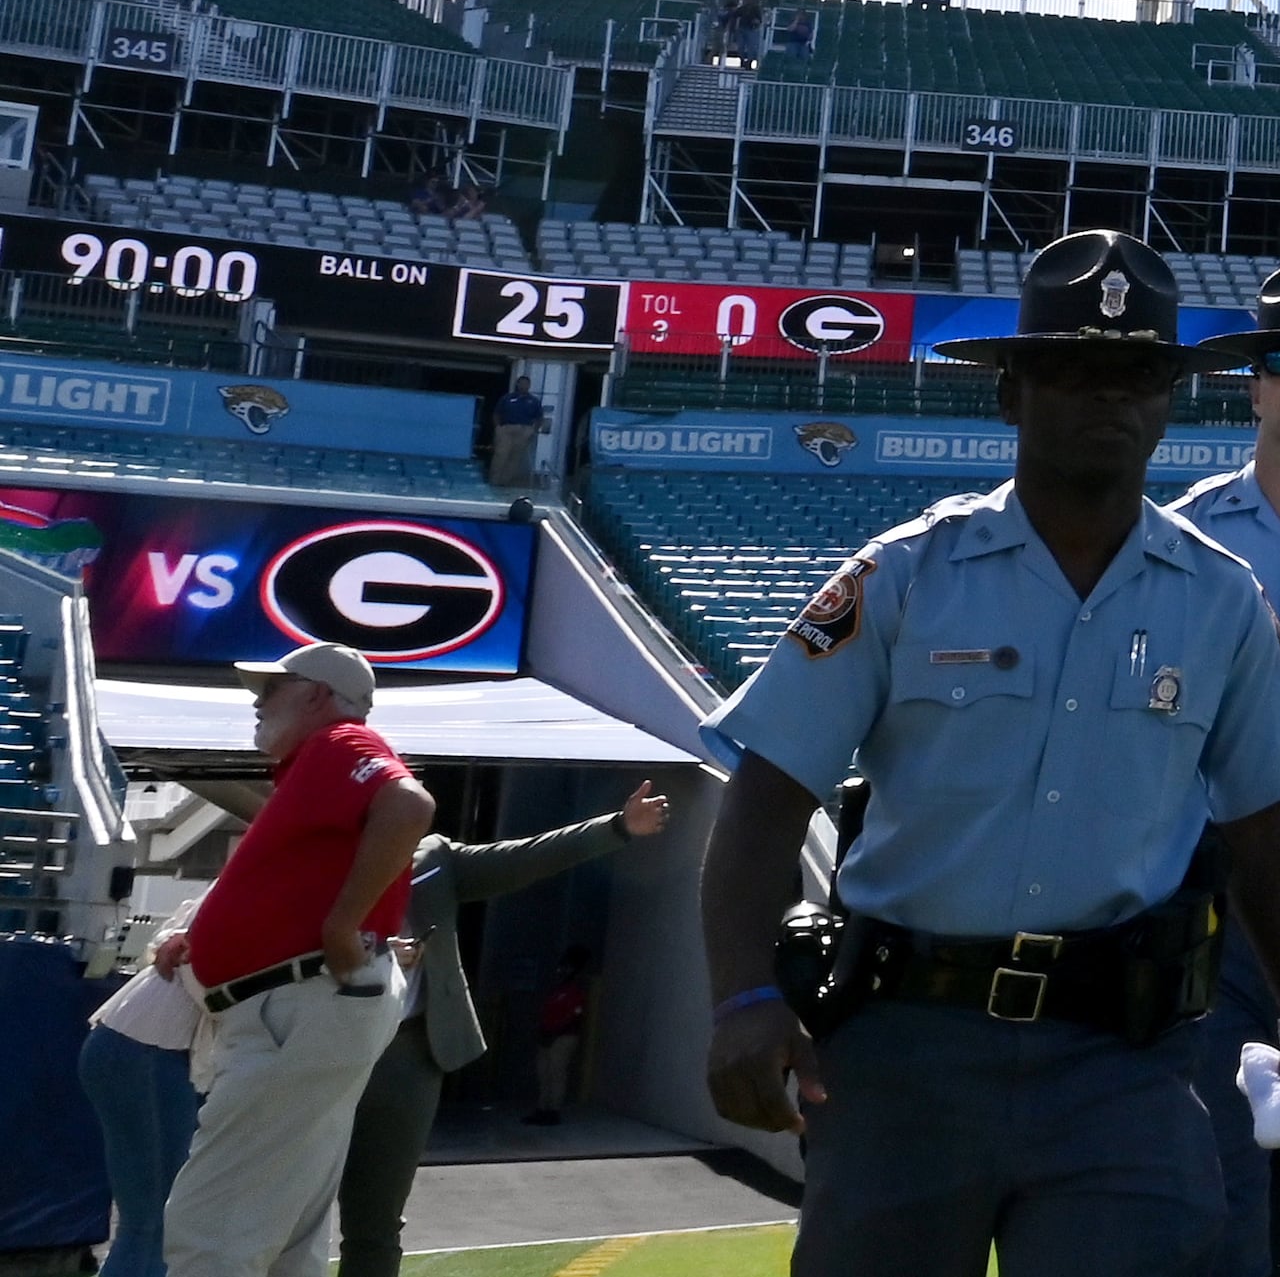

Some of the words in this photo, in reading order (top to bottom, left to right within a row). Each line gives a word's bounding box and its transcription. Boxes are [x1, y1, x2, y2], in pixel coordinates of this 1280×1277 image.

[112, 36, 168, 63] 345
[966, 125, 1014, 148] 346
[60, 233, 258, 302] 90:00
[319, 255, 384, 282] BALL
[390, 263, 428, 286] ON
[495, 280, 586, 340] 25
[641, 293, 682, 316] TOL
[650, 320, 669, 343] 3
[716, 294, 757, 346] 0
[10, 373, 160, 415] LIGHT
[600, 428, 669, 454] BUD
[671, 430, 767, 455] LIGHT
[881, 435, 948, 459] BUD
[1151, 444, 1213, 465] BUD
[147, 551, 239, 609] VS
[798, 622, 834, 652] PATROL
